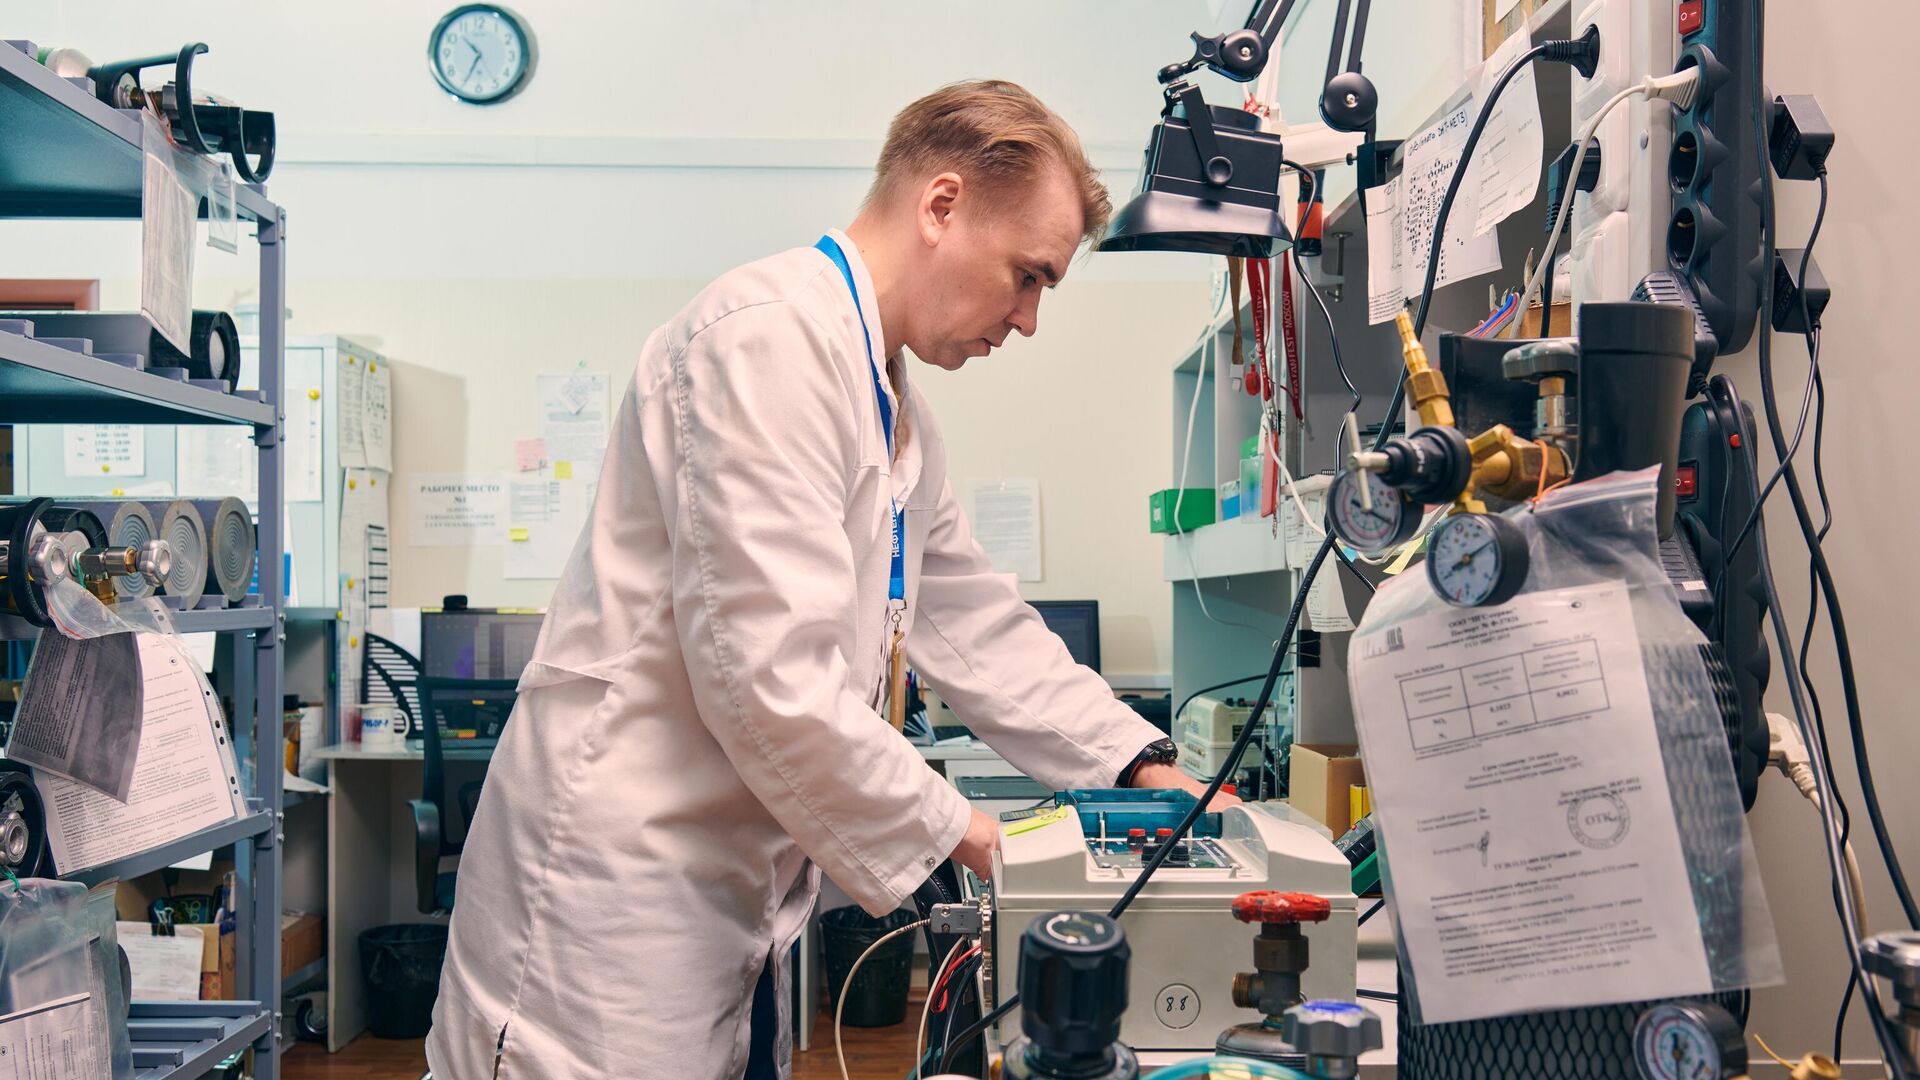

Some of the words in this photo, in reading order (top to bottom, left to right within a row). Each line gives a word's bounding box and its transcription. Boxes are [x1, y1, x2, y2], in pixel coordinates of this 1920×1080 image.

[1281, 290, 1293, 329] MOSCOW
[420, 484, 462, 493] РАБОЧЕЕ
[466, 484, 500, 493] МЕСТО
[1584, 811, 1612, 826] ОТК
